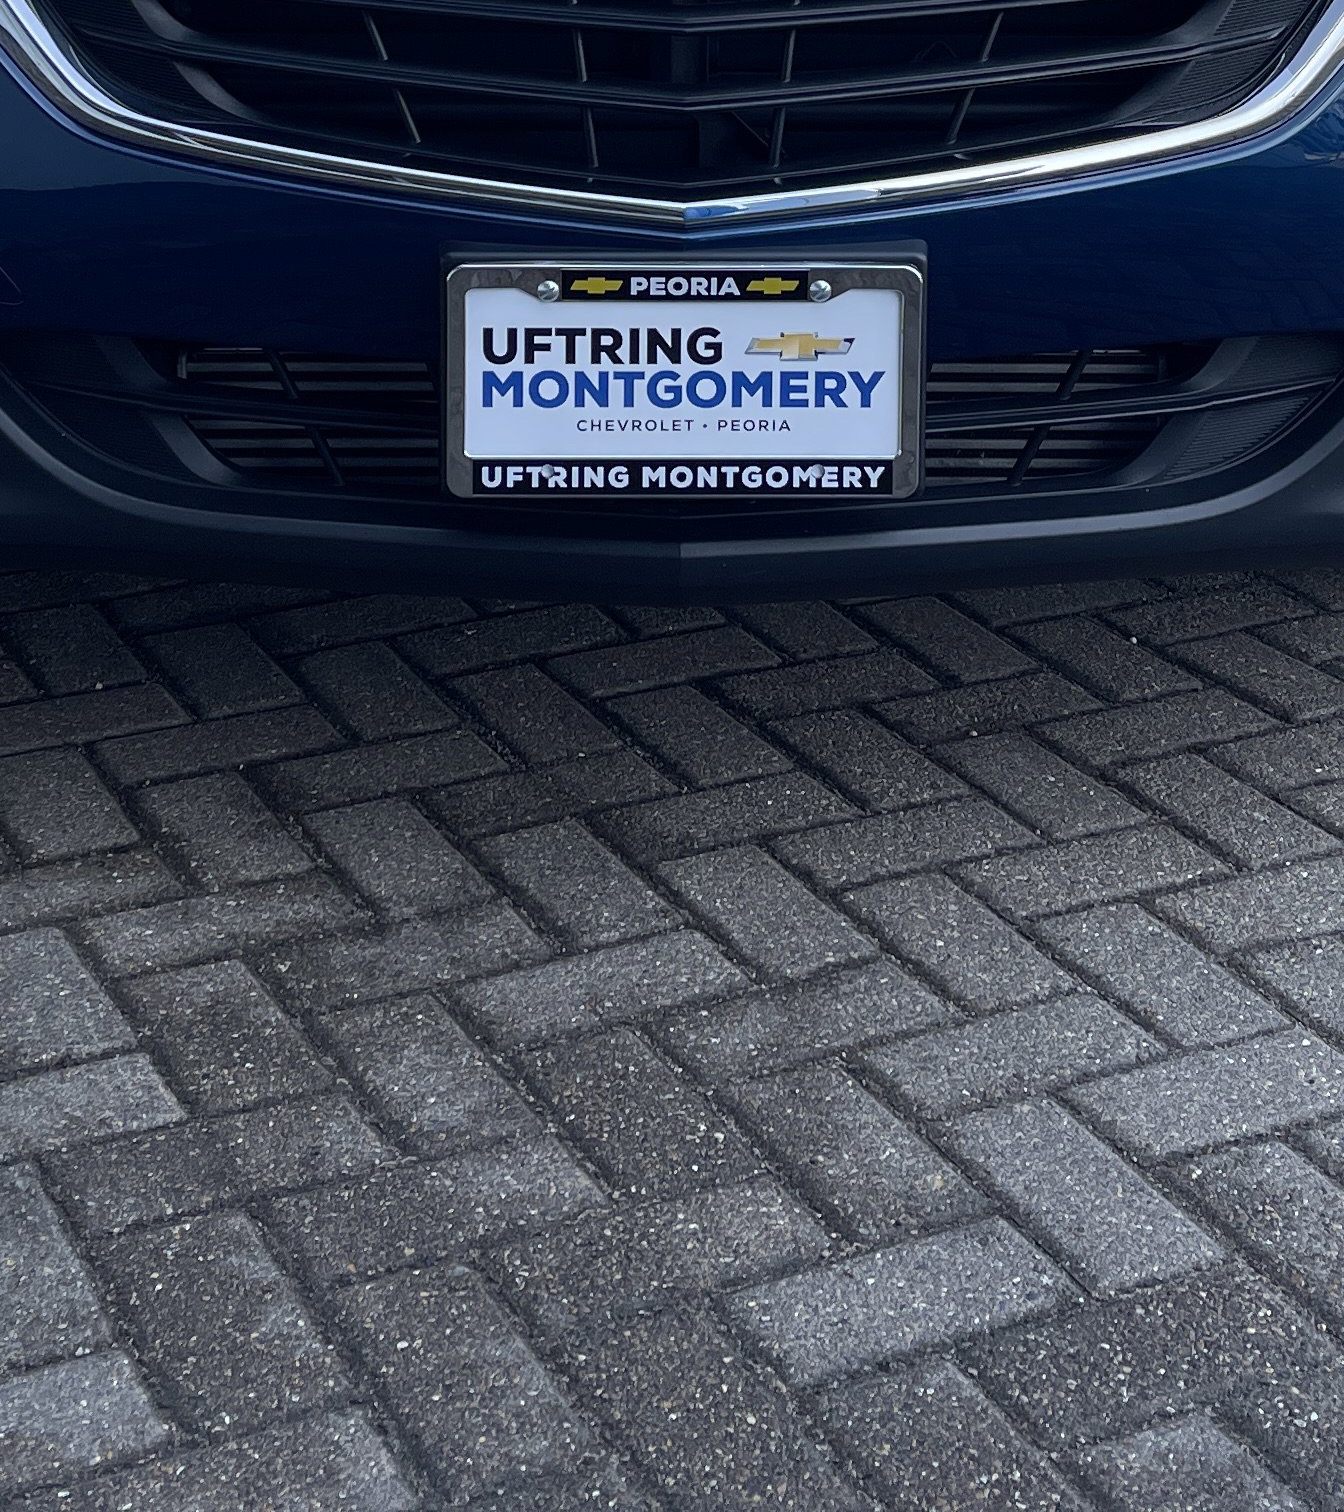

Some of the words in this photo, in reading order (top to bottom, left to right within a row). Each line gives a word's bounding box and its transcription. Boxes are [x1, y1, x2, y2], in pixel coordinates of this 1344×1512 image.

[630, 276, 741, 296] PEORIA
[482, 327, 723, 365] UFTRING
[482, 370, 886, 408] MONTGOMERY
[576, 419, 695, 432] CHEVROLET
[717, 419, 791, 432] PEORIA
[481, 465, 630, 489] UFTRING
[641, 465, 886, 489] MONTGOMERY
